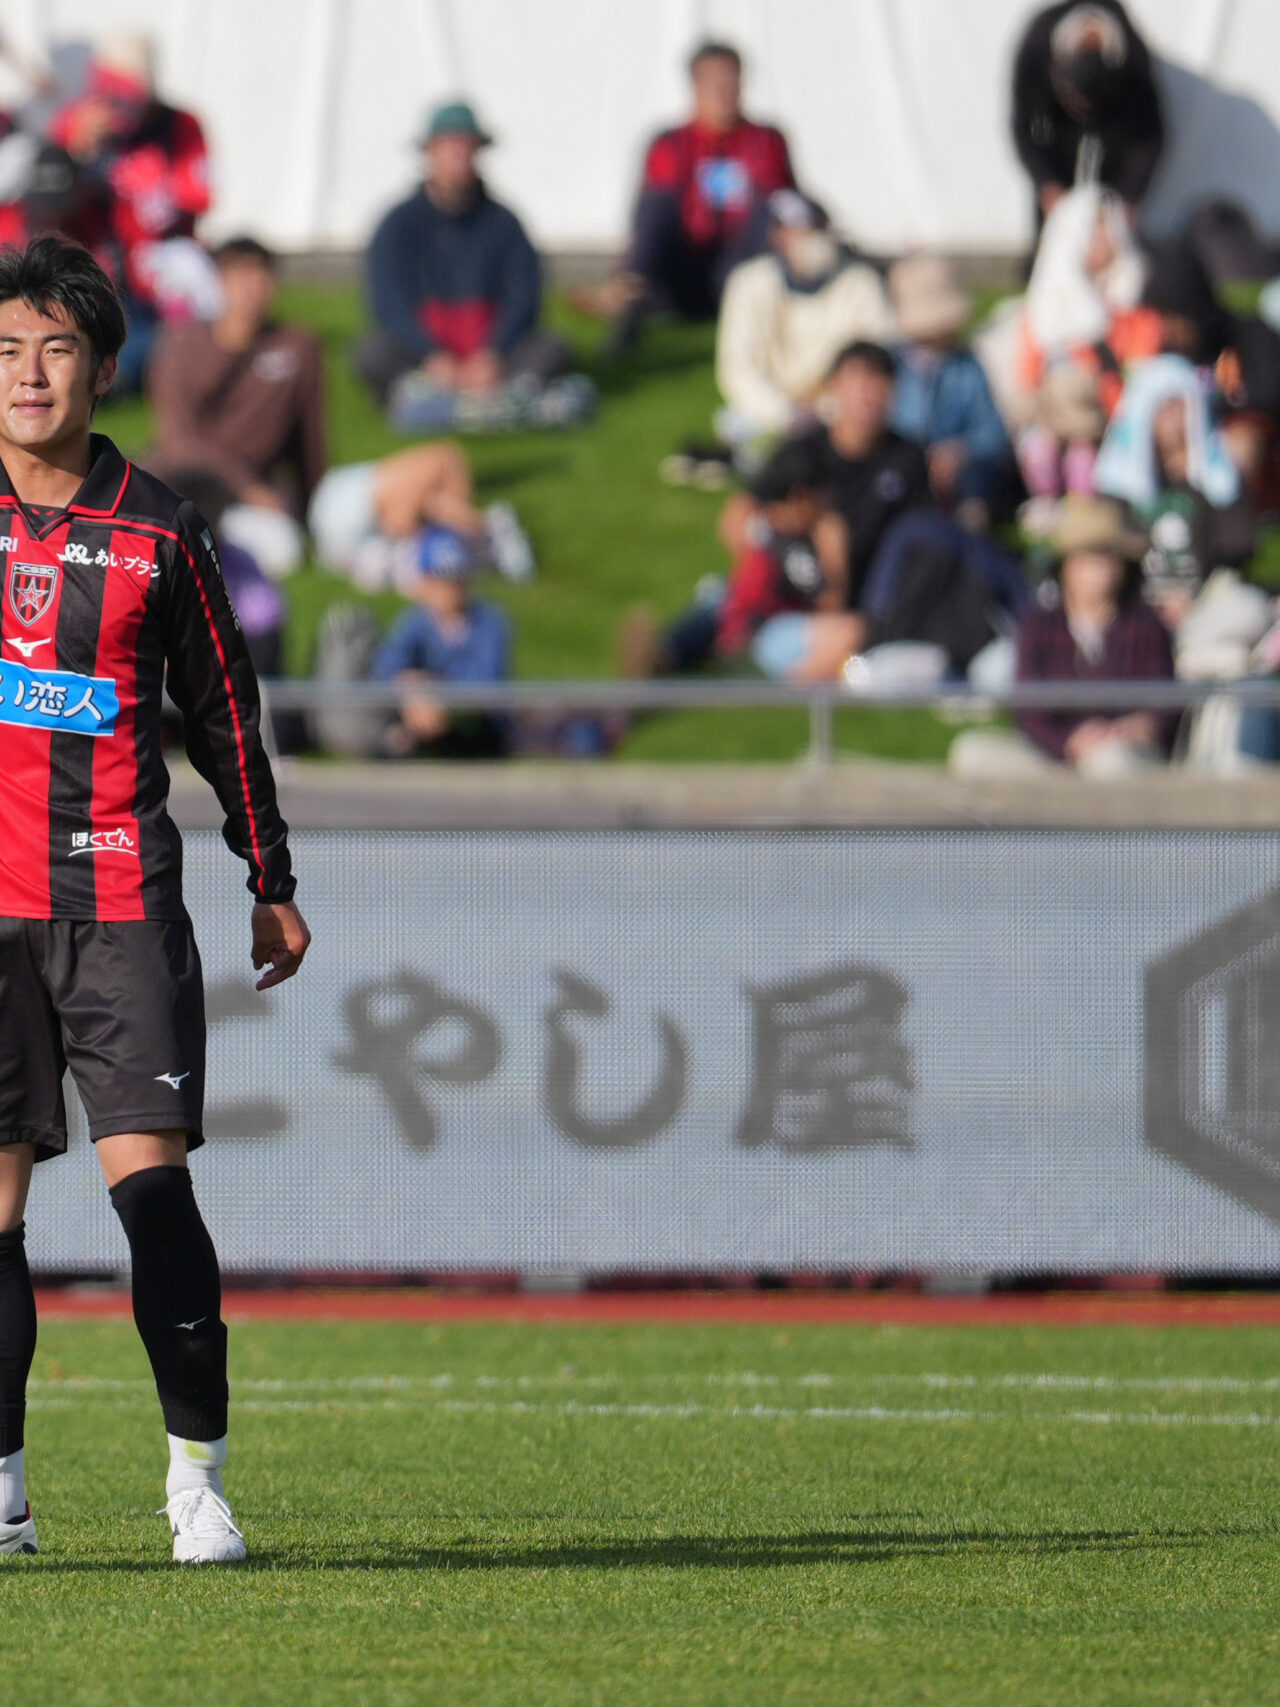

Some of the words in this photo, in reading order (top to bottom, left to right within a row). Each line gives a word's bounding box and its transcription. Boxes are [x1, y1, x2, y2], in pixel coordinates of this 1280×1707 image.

[94, 548, 161, 578] あいプラン
[71, 827, 135, 848] ほくでん
